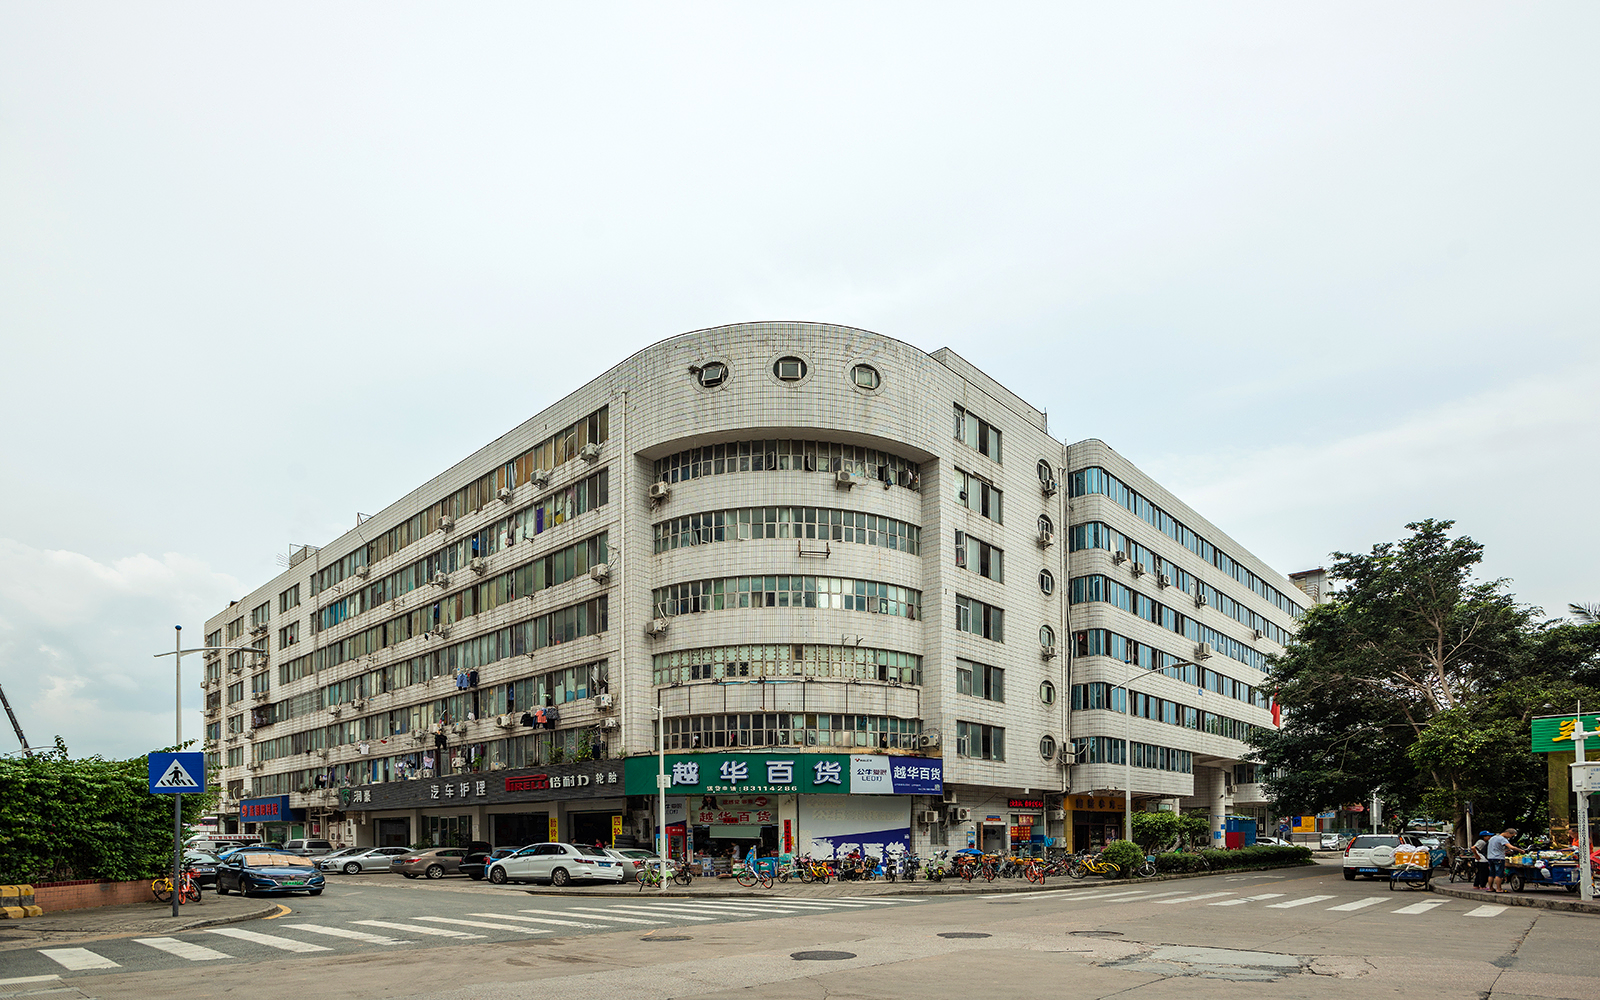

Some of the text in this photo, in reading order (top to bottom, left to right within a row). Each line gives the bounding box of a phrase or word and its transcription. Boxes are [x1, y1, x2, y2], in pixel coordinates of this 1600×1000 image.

[505, 771, 618, 792] PIRELLI 倍耐力 轮胎
[672, 760, 842, 785] 越华百货
[893, 765, 941, 781] 越华百货
[430, 780, 486, 799] 汽车护理
[699, 811, 772, 823] 越华百货
